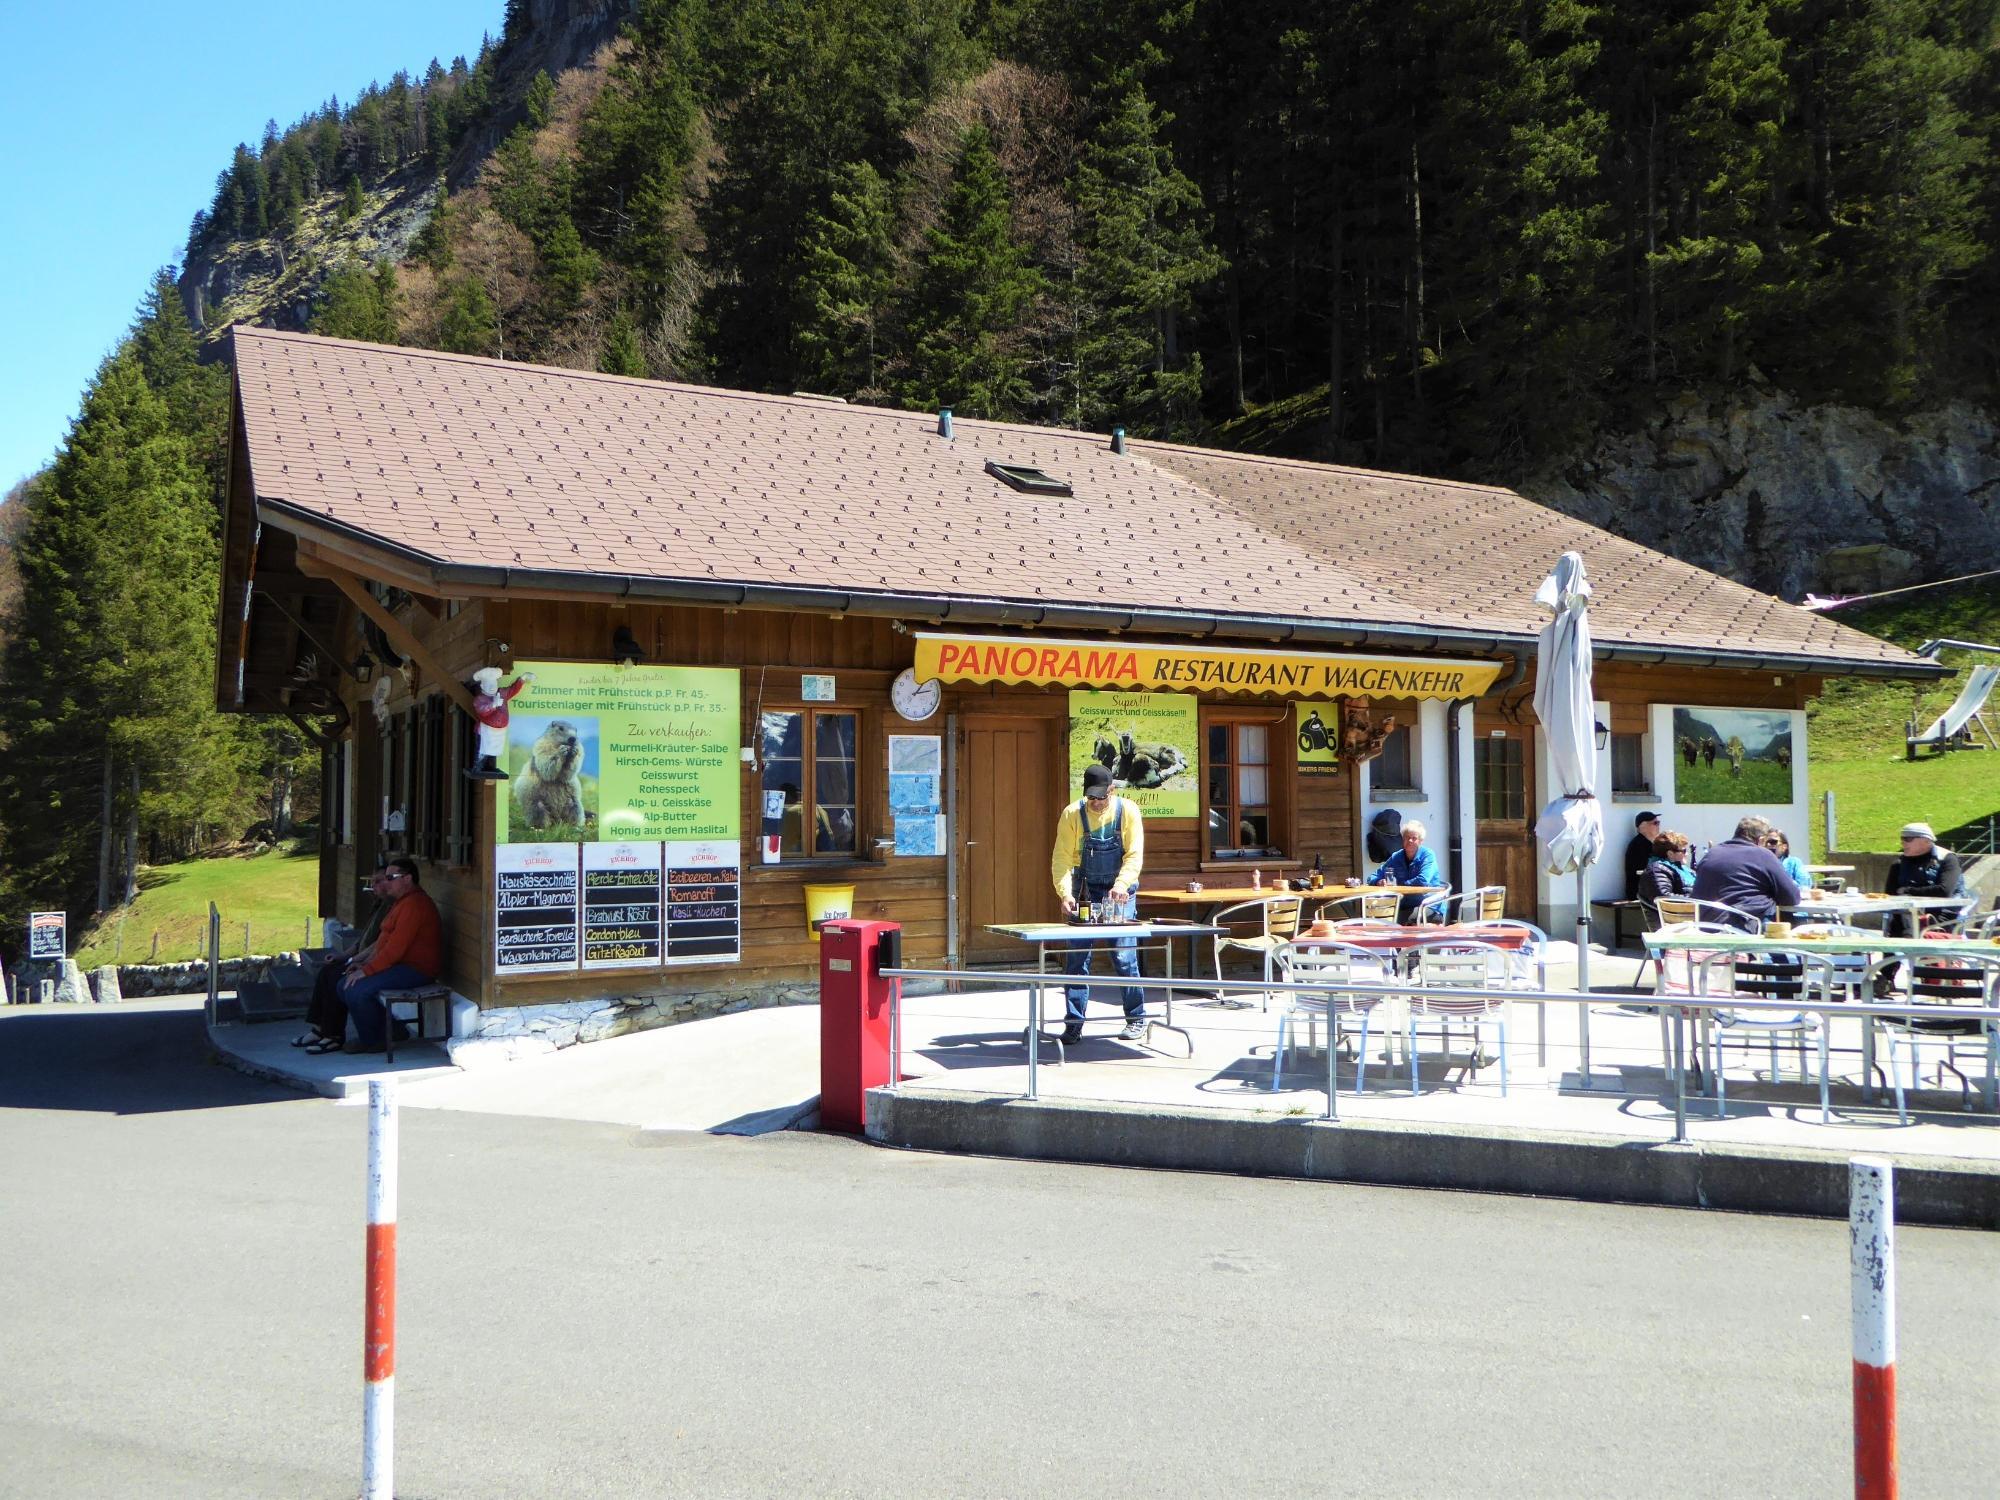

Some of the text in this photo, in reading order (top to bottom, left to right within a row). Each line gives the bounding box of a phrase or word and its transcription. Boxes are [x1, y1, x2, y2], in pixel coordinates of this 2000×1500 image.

[937, 643, 1464, 694] PANORAMA RESTAURANT WAGENKEHR
[531, 685, 574, 696] Zimmer
[577, 686, 595, 696] mit
[599, 686, 652, 698] Frühstück
[676, 690, 687, 699] Fr.
[512, 700, 593, 712] Touristenlager
[596, 701, 614, 710] mit
[618, 701, 670, 712] Frühstück
[694, 704, 705, 713] Fr.
[1112, 695, 1151, 712] Super!!!
[1079, 707, 1125, 717] Geisswurst
[1126, 708, 1141, 716] und
[627, 721, 712, 741] Zu verkaufen:
[701, 744, 728, 753] Salbe
[686, 757, 723, 767] Würste
[641, 770, 699, 780] Geisswurst
[639, 784, 700, 794] Rohesspeck
[627, 798, 647, 808] Alp-
[662, 798, 712, 807] Geisskäse
[643, 812, 697, 822] Alp-Butter
[610, 825, 728, 836] Honig aus dem Haslital
[500, 872, 576, 889] Hauskäseschnitte
[670, 871, 712, 884] Erdbeeren
[671, 886, 716, 902] Romanoff
[627, 906, 651, 922] Rösti
[544, 927, 575, 943] Forelle
